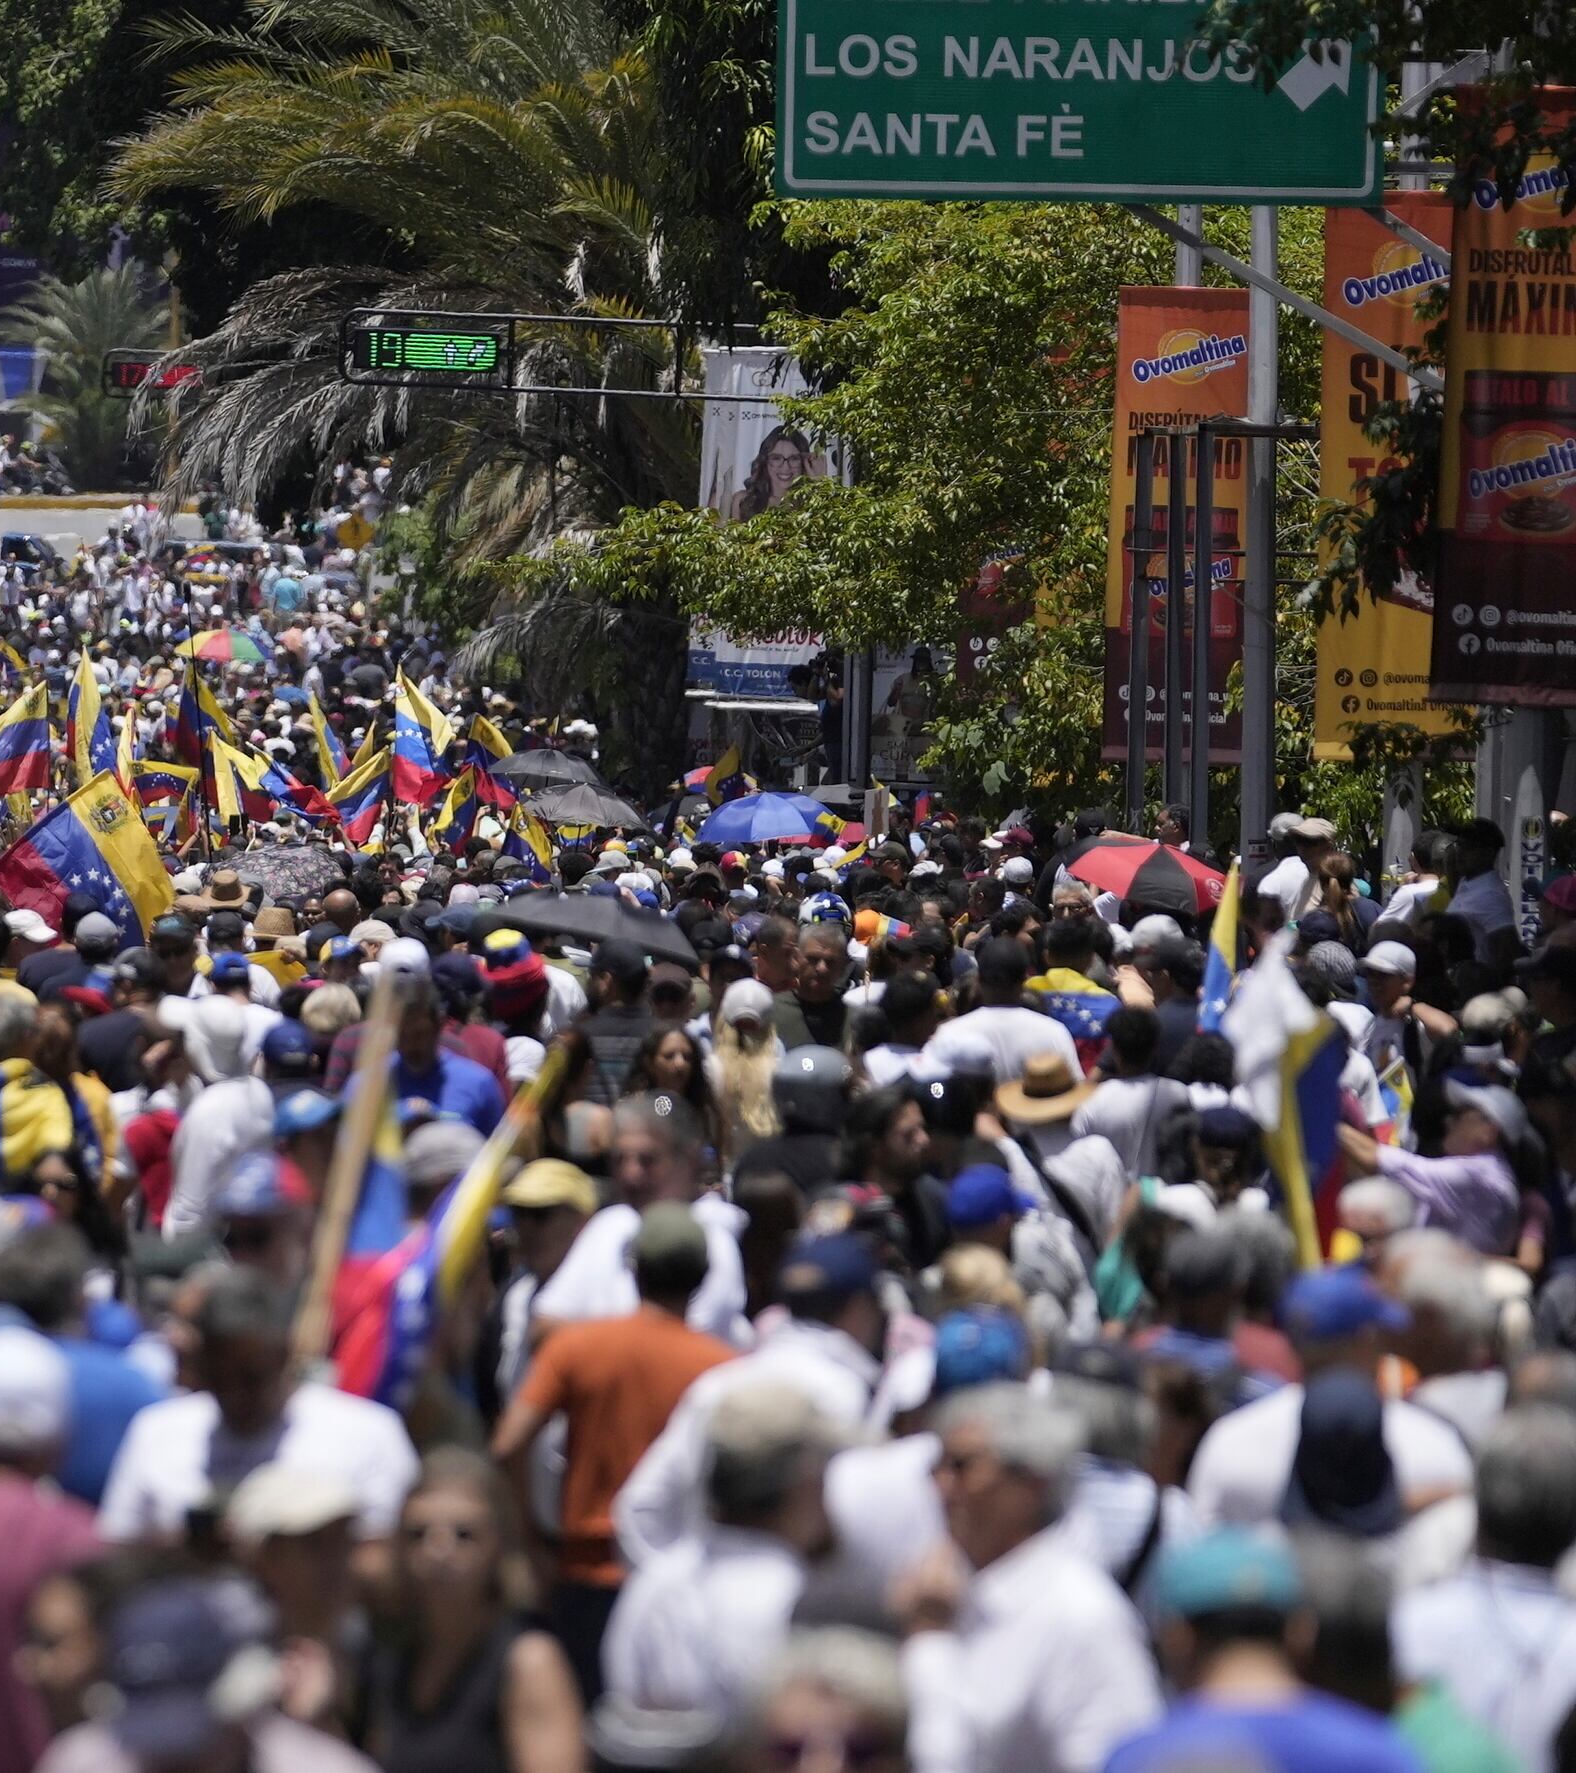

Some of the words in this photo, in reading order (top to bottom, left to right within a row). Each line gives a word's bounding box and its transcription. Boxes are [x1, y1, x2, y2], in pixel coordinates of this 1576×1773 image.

[805, 33, 918, 78] LOS
[943, 35, 1257, 82] NARANJOS
[804, 110, 997, 157] SANTA
[369, 332, 403, 367] 19
[1132, 334, 1246, 383] Ovomaltina
[1367, 698, 1427, 712] Ovomaltina
